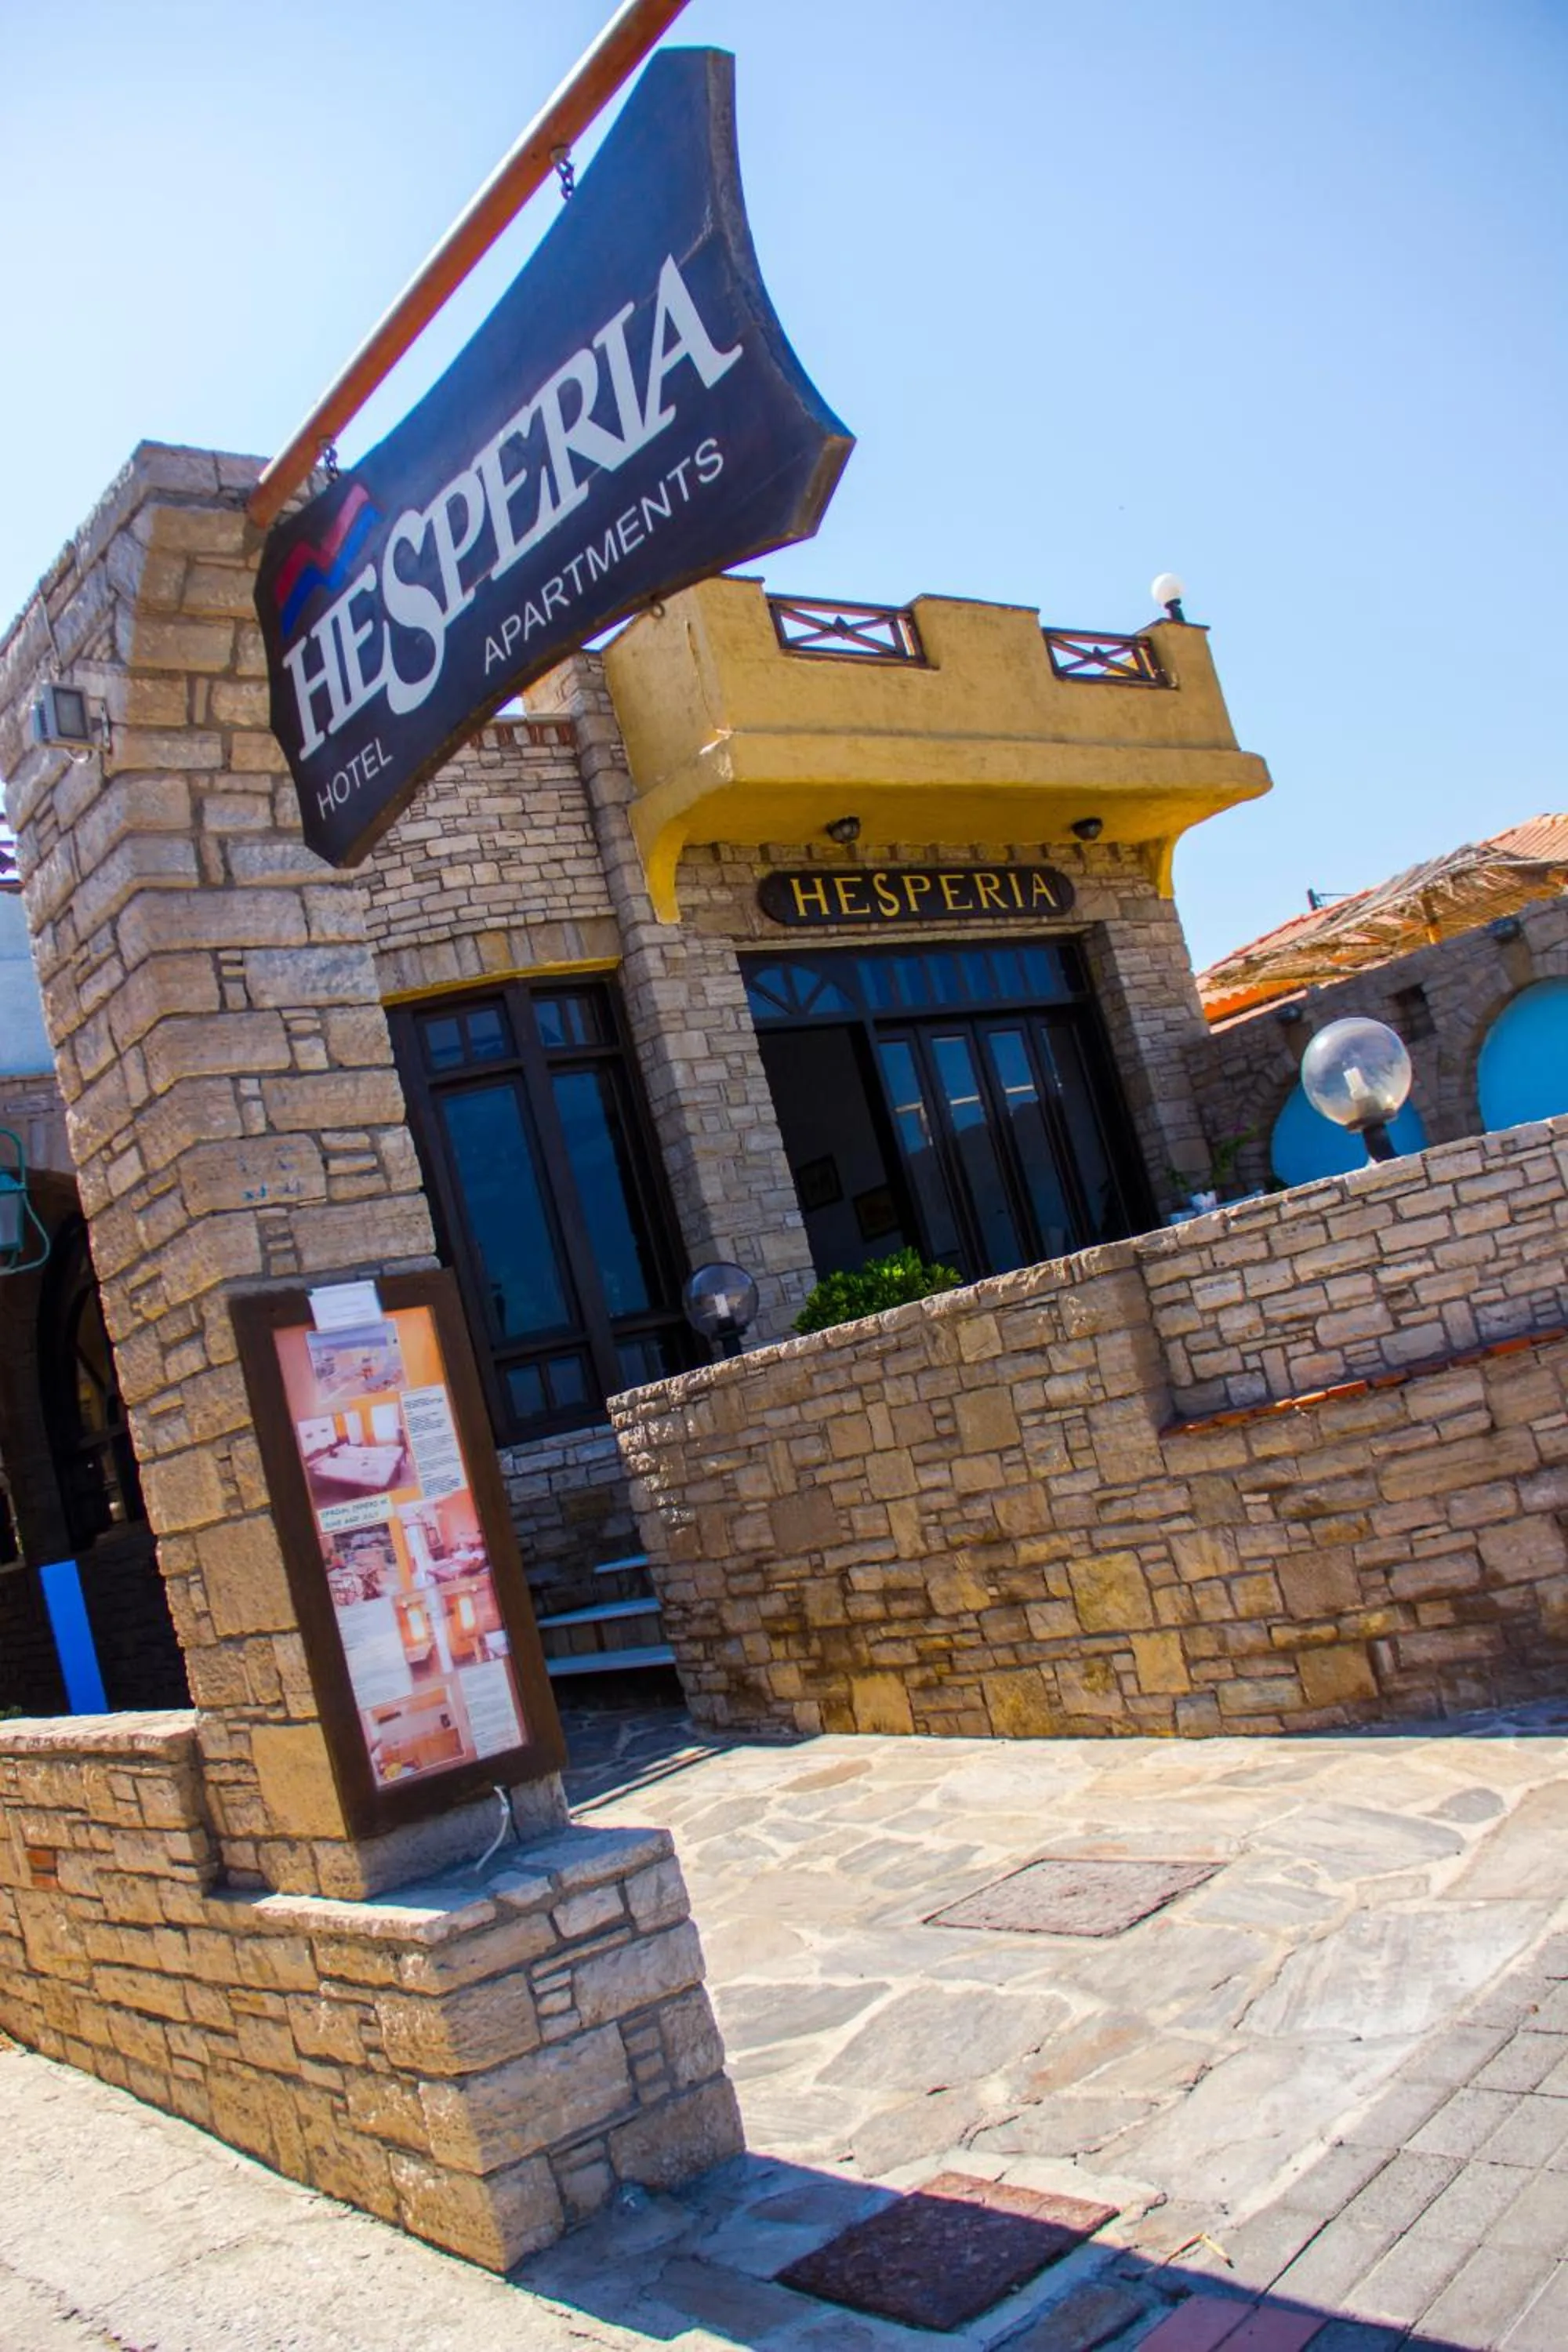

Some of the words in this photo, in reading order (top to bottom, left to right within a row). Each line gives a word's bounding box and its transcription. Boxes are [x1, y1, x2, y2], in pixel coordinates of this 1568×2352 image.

[283, 253, 742, 760] HESPERIA
[317, 737, 394, 821] HOTEL
[484, 437, 724, 676] APARTMENTS
[790, 873, 1058, 917] HESPERIA
